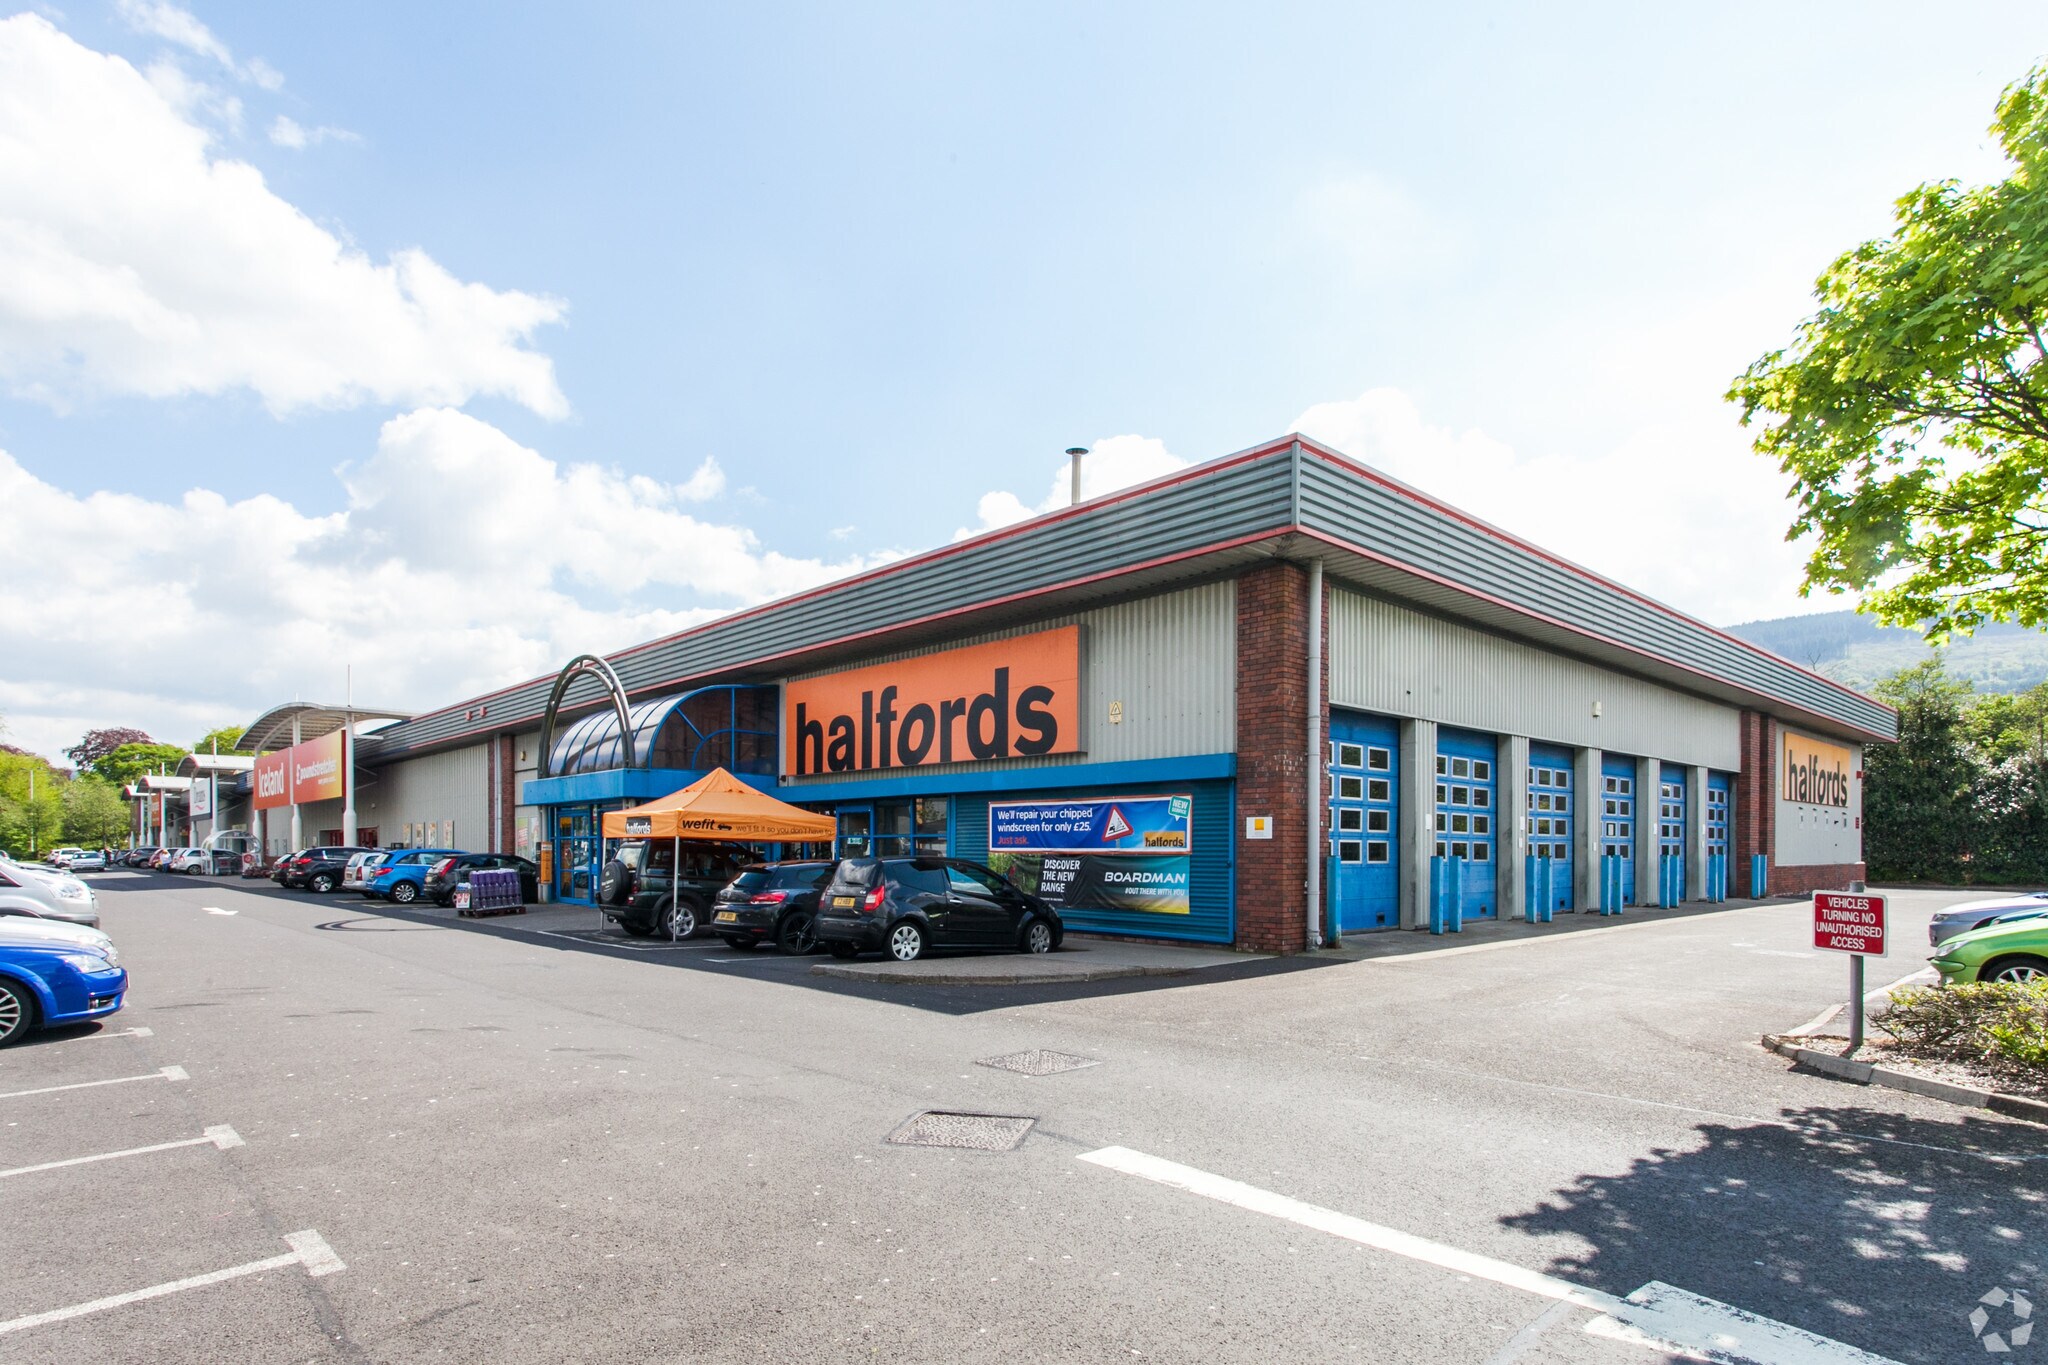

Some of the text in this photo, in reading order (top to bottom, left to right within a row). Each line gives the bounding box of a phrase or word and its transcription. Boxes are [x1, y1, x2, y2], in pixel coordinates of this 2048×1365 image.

[796, 667, 1058, 775] halfords
[258, 762, 284, 798] Iceland
[1788, 749, 1848, 806] halfords
[1172, 799, 1189, 809] NEW
[997, 807, 1093, 821] We'll repair your chipped
[626, 822, 651, 834] halfords
[682, 819, 715, 830] wefit
[997, 821, 1092, 834] windscreen for only £25.
[776, 827, 789, 835] you
[997, 835, 1029, 845] Just ask.
[1145, 836, 1184, 848] halfords
[1044, 859, 1081, 870] DISCOVER
[1043, 871, 1075, 882] THE NEW
[1104, 872, 1186, 883] BOARDMAN
[1041, 882, 1066, 893] RANGE
[1827, 897, 1869, 911] VEHICLES
[1822, 909, 1876, 924] TURNING NO
[1816, 922, 1882, 938] UNAUTHORISED
[1830, 937, 1866, 950] ACCESS
